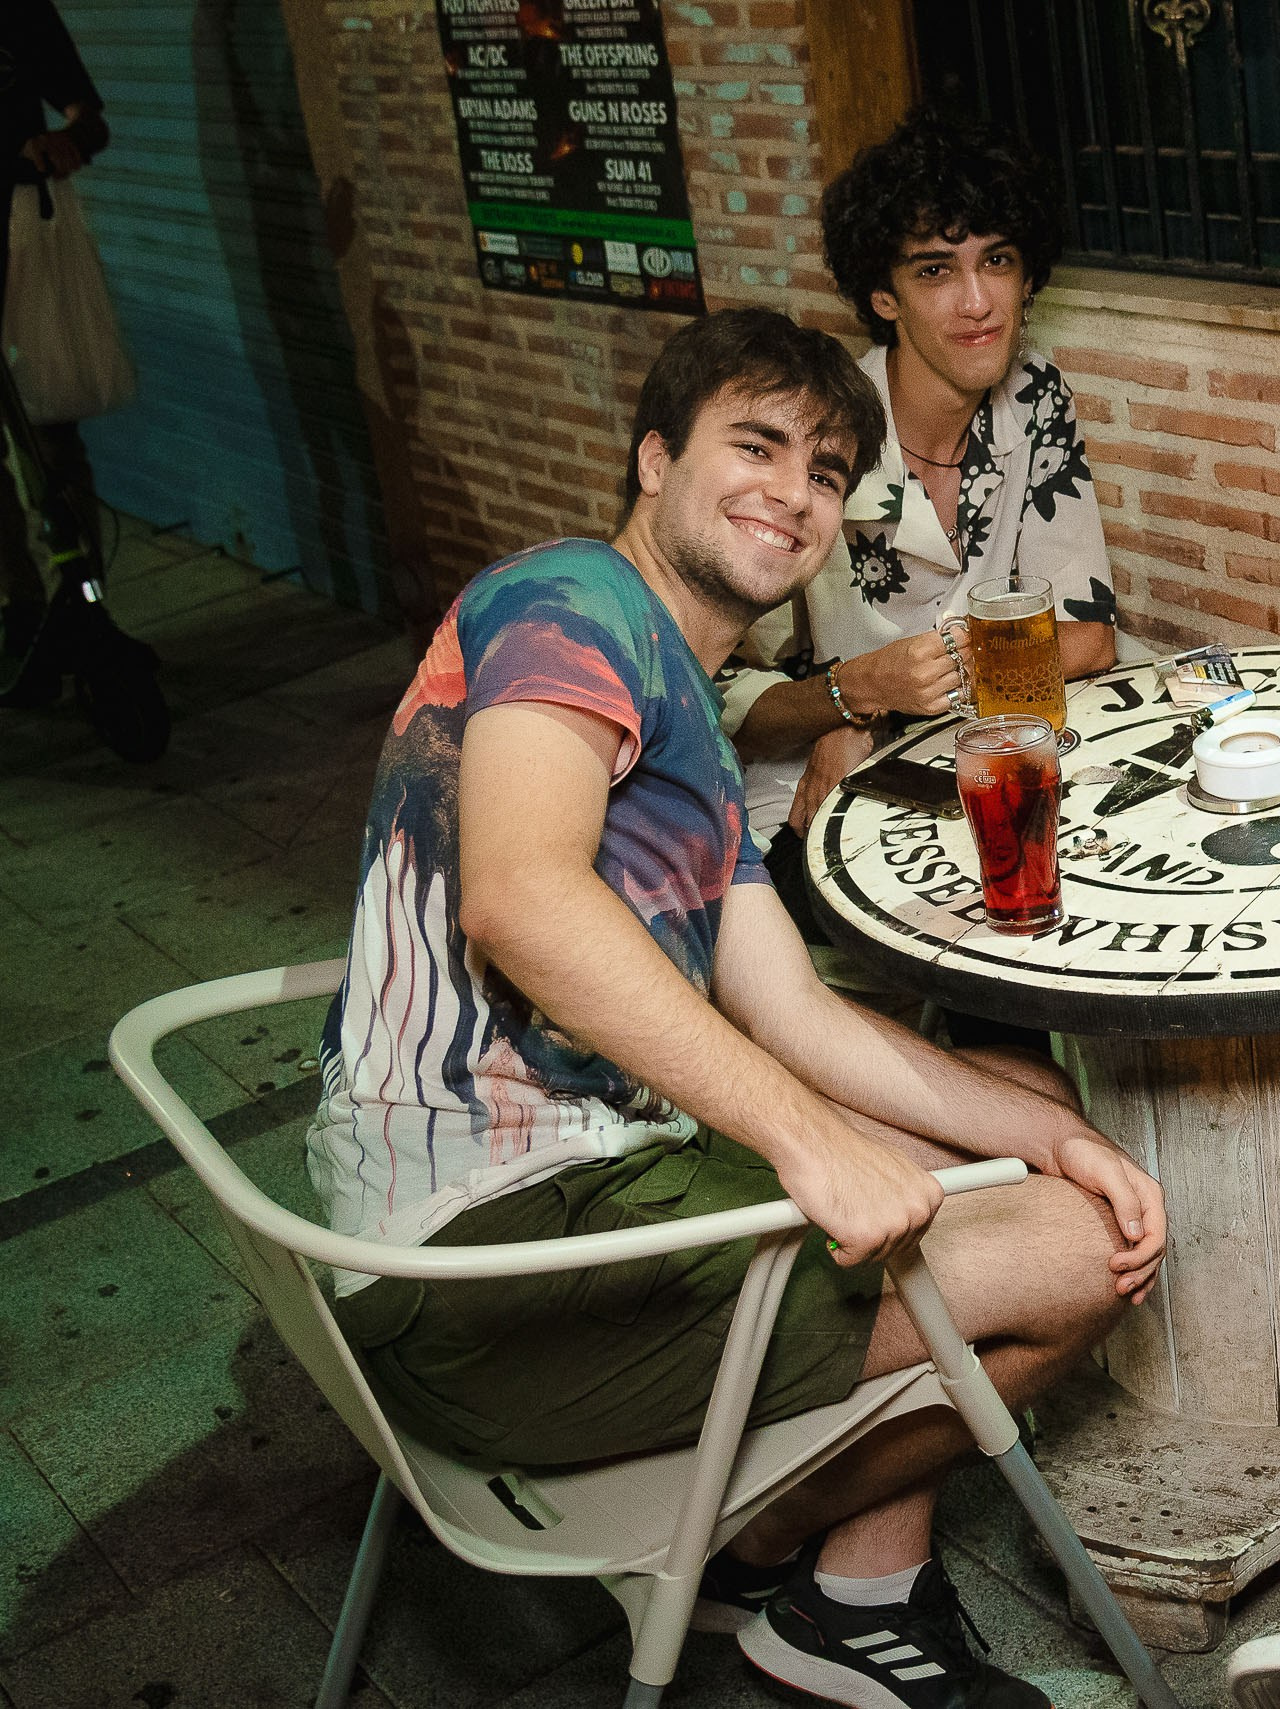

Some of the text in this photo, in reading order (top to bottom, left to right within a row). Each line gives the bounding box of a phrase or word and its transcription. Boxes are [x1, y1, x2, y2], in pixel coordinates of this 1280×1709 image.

[468, 44, 508, 68] AC/DC
[559, 43, 659, 67] THE OFFSPRING
[494, 99, 538, 121] ADAMS
[568, 100, 668, 125] GUNS N ROSES
[480, 149, 502, 171] THE
[604, 158, 653, 182] SUM 41
